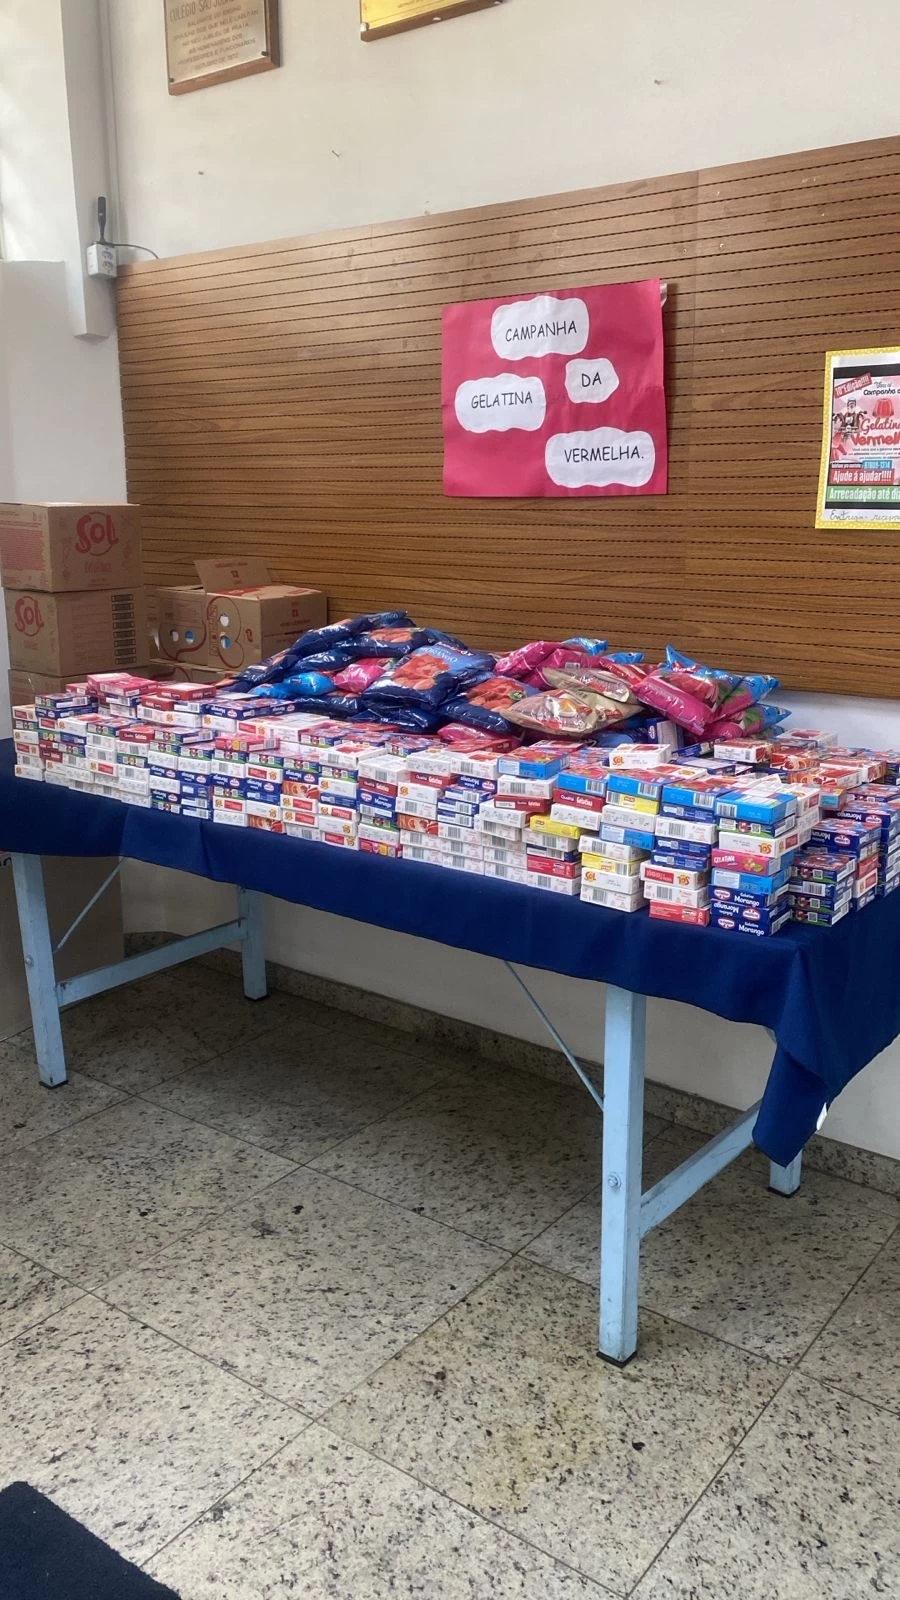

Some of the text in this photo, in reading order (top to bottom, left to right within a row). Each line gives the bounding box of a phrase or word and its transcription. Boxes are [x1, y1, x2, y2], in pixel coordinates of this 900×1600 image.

[505, 320, 577, 342] CAMPANHA
[581, 372, 602, 387] DA
[471, 391, 533, 409] GELATINA
[861, 416, 900, 435] Gelatin
[564, 446, 644, 463] VERMELHA.
[833, 470, 853, 484] Ajude
[829, 488, 877, 502] Arrecadação
[877, 488, 890, 500] até
[713, 901, 740, 914] Morango
[734, 894, 760, 907] Morango
[738, 924, 765, 937] Morango
